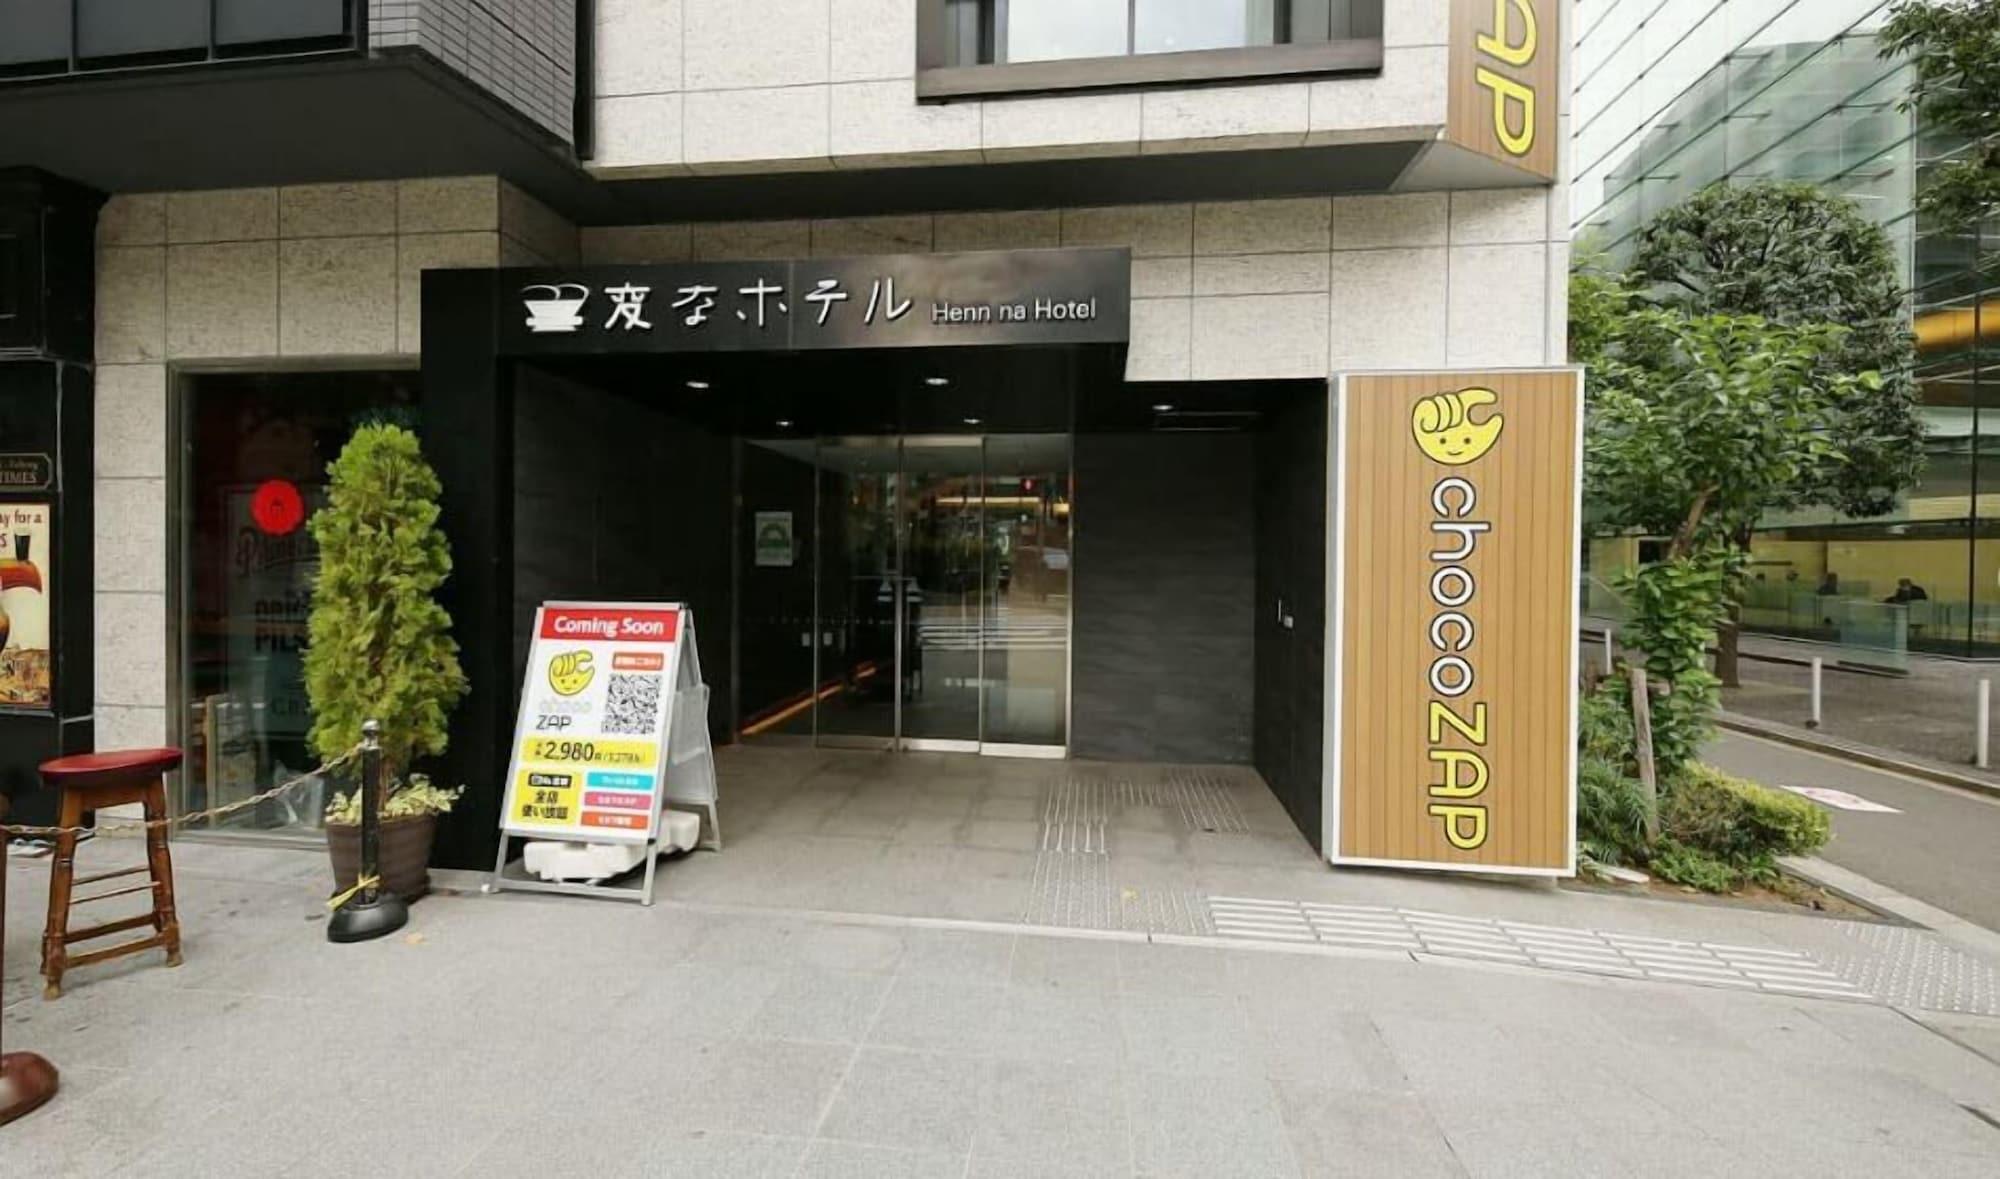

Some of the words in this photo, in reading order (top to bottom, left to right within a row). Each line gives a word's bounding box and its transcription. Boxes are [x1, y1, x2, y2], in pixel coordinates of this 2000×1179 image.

[604, 277, 912, 330] 変なホテル
[931, 302, 991, 322] Henn
[999, 304, 1027, 320] na
[1034, 298, 1096, 319] Hotel
[15, 509, 31, 523] for
[34, 514, 42, 523] a
[554, 616, 618, 638] Coming
[621, 618, 664, 635] Soon
[1428, 476, 1491, 850] chocoZAP
[535, 714, 572, 732] ZAP
